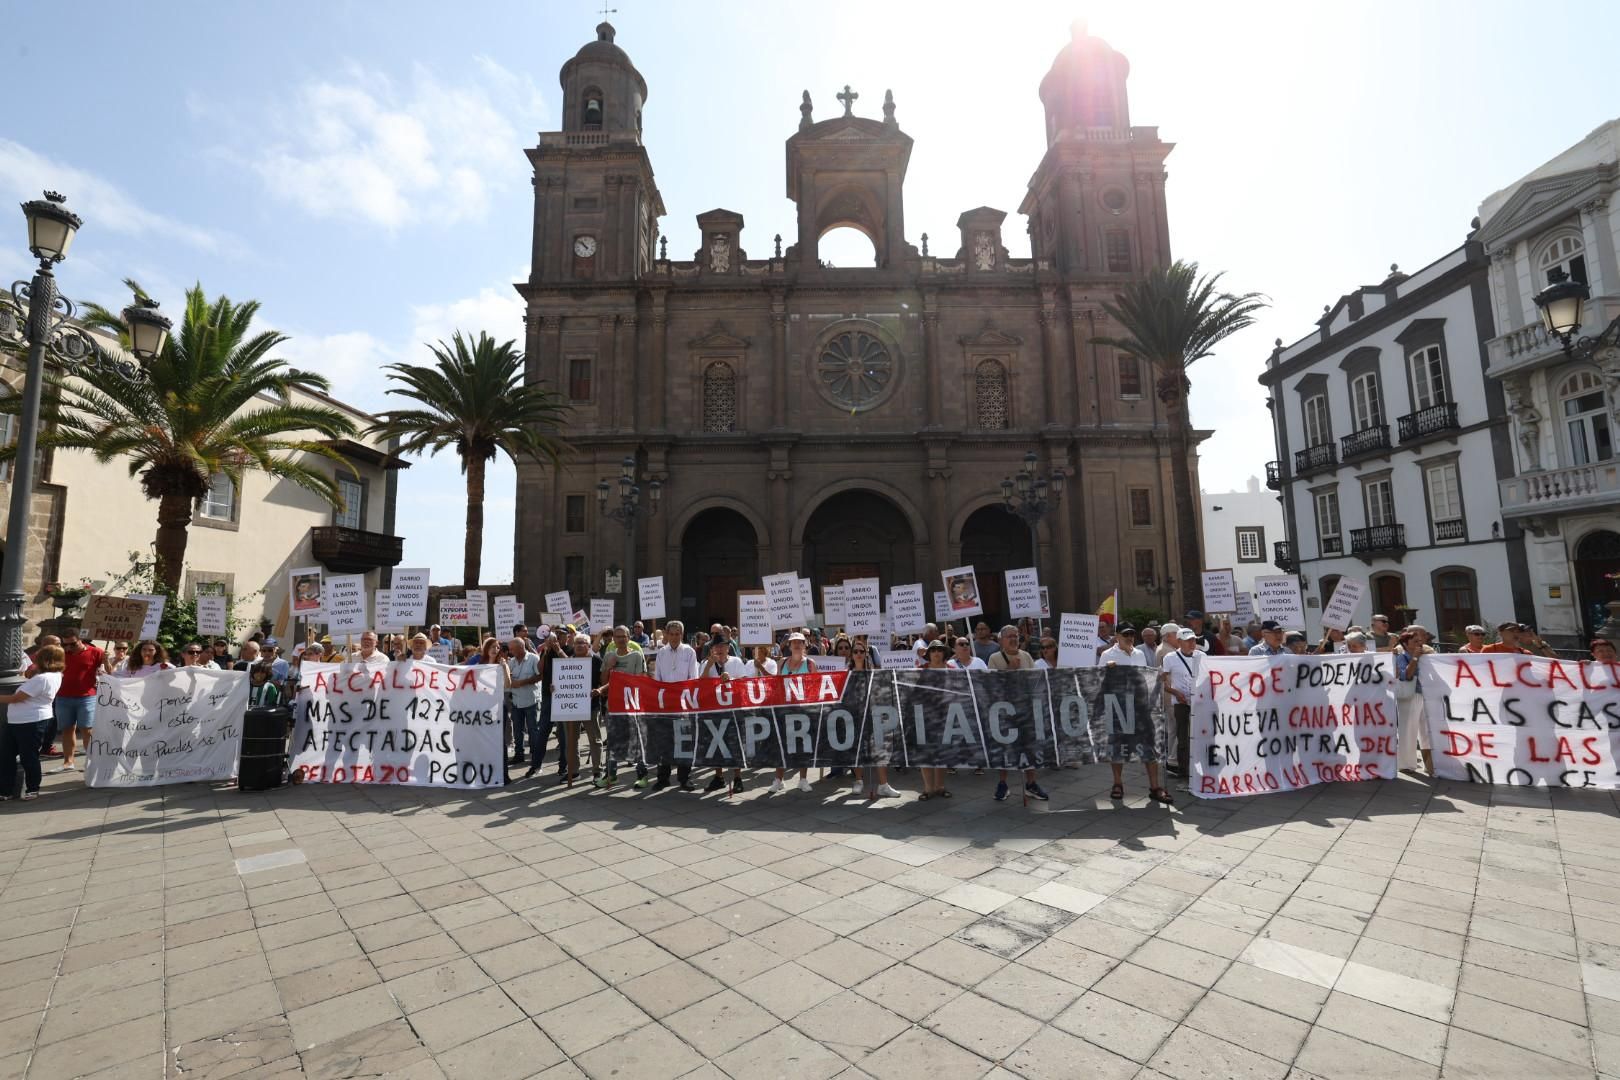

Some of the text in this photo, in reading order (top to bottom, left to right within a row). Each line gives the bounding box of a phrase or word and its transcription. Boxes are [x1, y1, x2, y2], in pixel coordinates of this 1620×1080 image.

[777, 587, 793, 595] RISCO
[1335, 598, 1352, 606] UNIDOS
[94, 628, 134, 640] PUEBLO
[623, 674, 839, 710] NINGUNA
[305, 699, 353, 723] MAS
[361, 699, 390, 721] DE
[405, 697, 445, 721] 127
[560, 702, 579, 710] LPGC
[1443, 695, 1526, 726] LAS
[1212, 708, 1280, 736] NUEVA
[1208, 733, 1397, 766] EN CONTRA DEL
[1440, 730, 1601, 765] DE LAS
[300, 764, 409, 784] PELOTAZO
[1312, 761, 1381, 783] TORRES
[1466, 762, 1534, 786] NO
